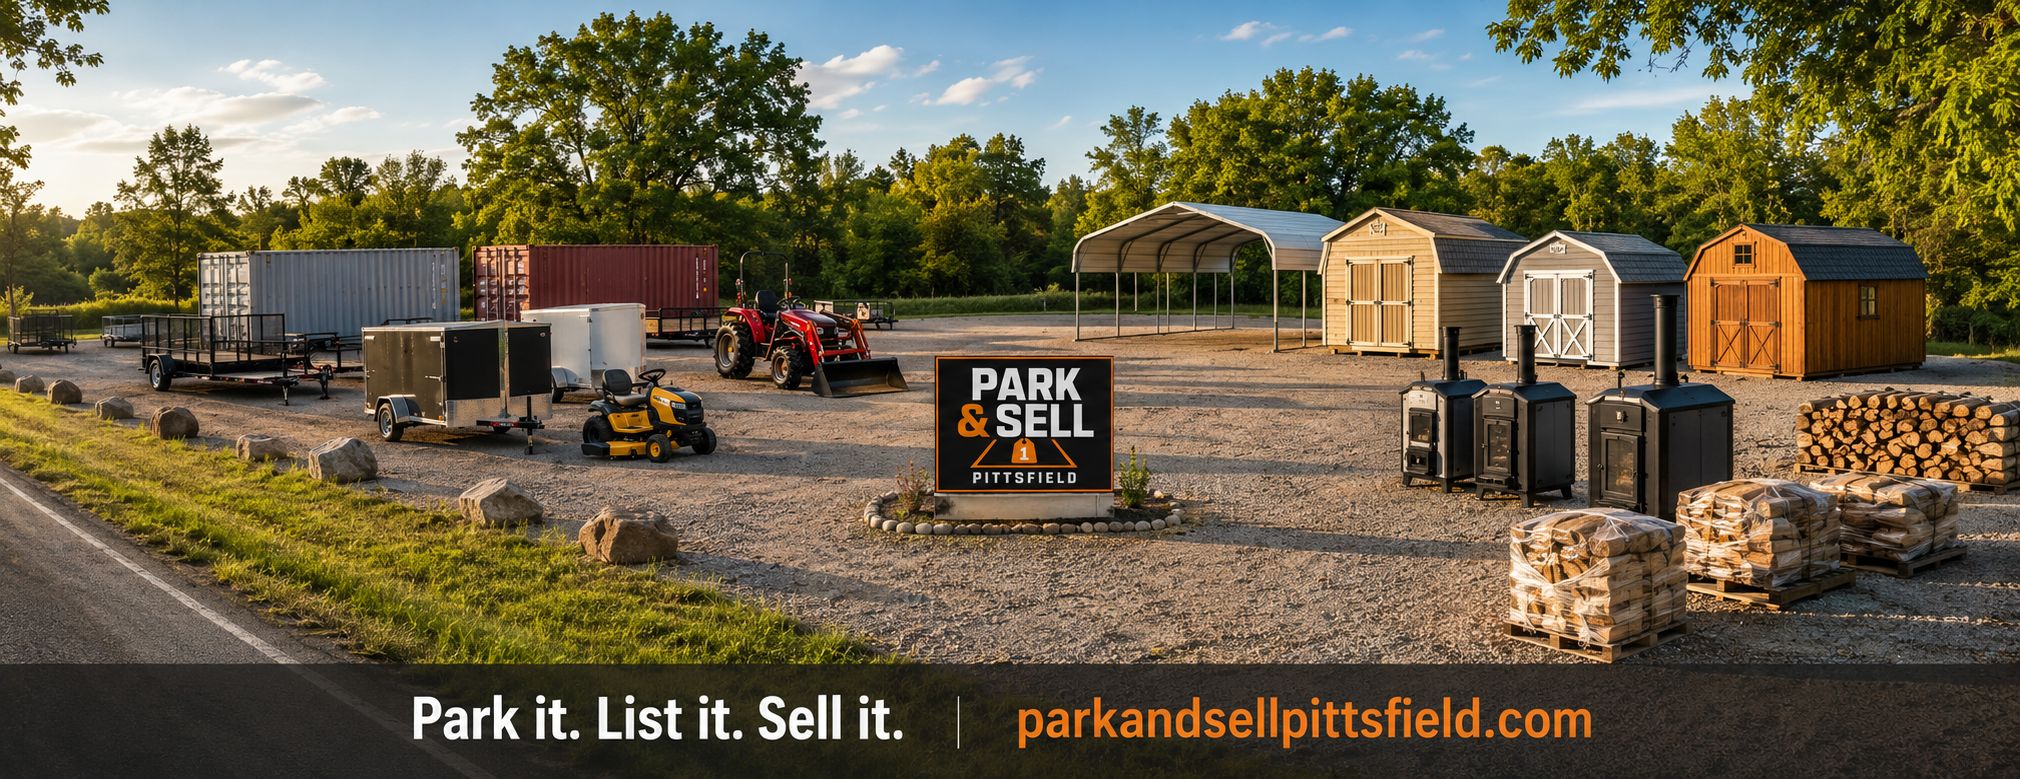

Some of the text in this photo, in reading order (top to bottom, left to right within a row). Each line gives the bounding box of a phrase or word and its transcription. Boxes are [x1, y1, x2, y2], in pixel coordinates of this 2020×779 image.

[972, 367, 1082, 401] PARK
[957, 403, 1095, 438] & SELL
[1019, 446, 1030, 461] 1
[972, 471, 1077, 484] PITTSFIELD
